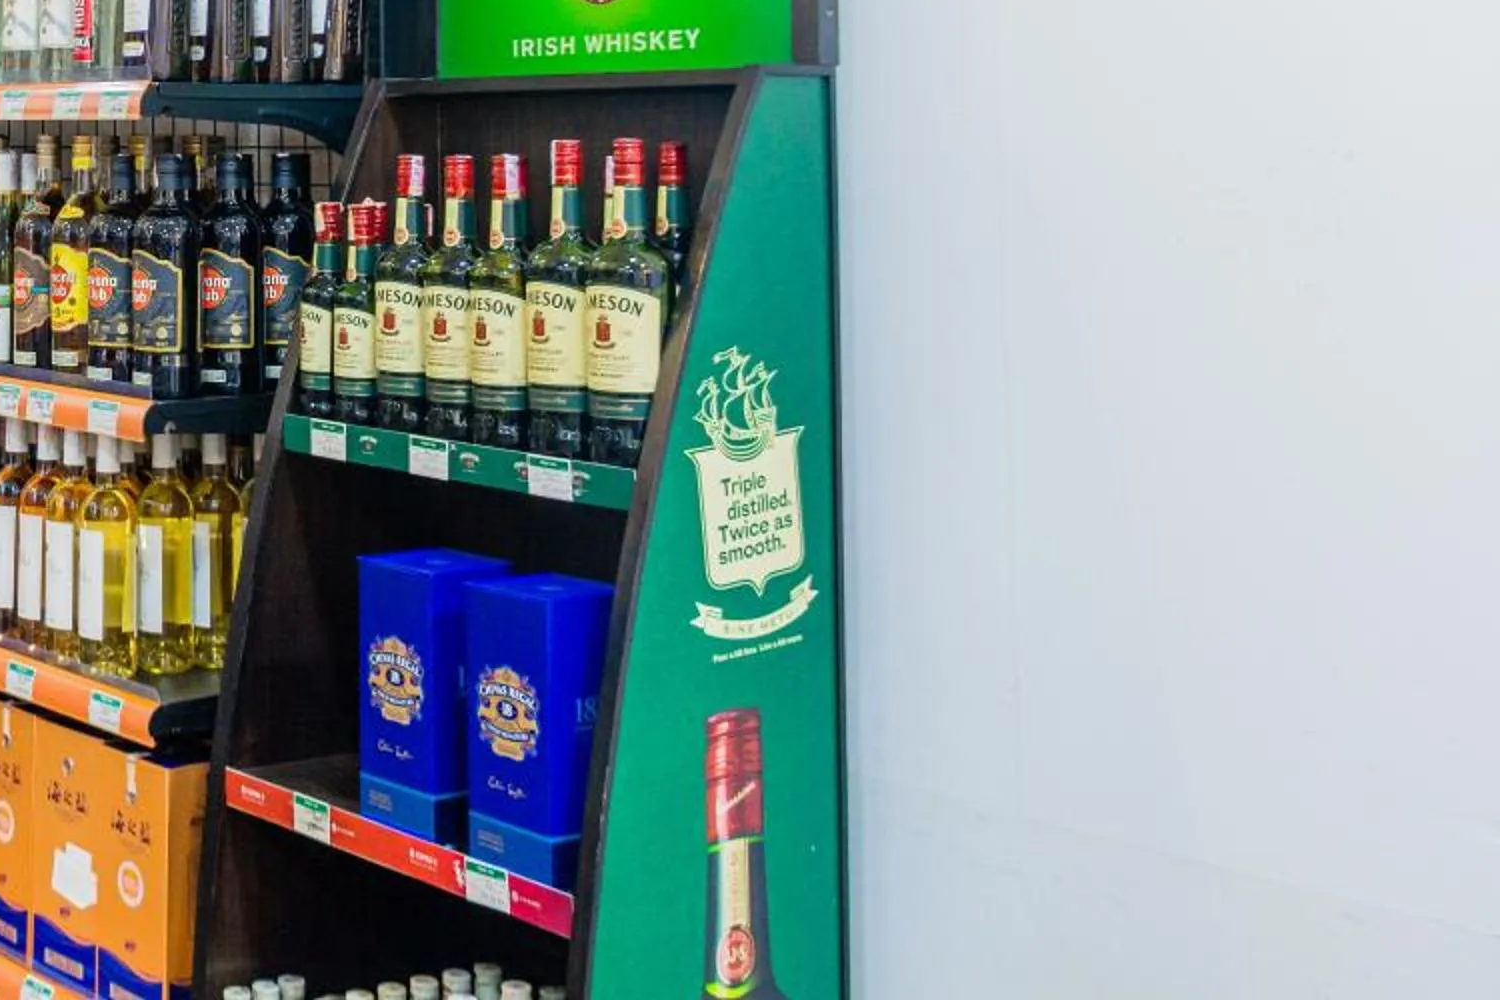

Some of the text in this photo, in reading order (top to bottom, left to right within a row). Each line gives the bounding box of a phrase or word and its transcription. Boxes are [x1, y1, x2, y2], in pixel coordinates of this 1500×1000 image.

[512, 27, 701, 58] IRISH WHISKEY
[720, 472, 766, 498] Triple
[718, 514, 793, 544] Twice as
[718, 534, 787, 565] smooth.
[577, 697, 597, 723] 18
